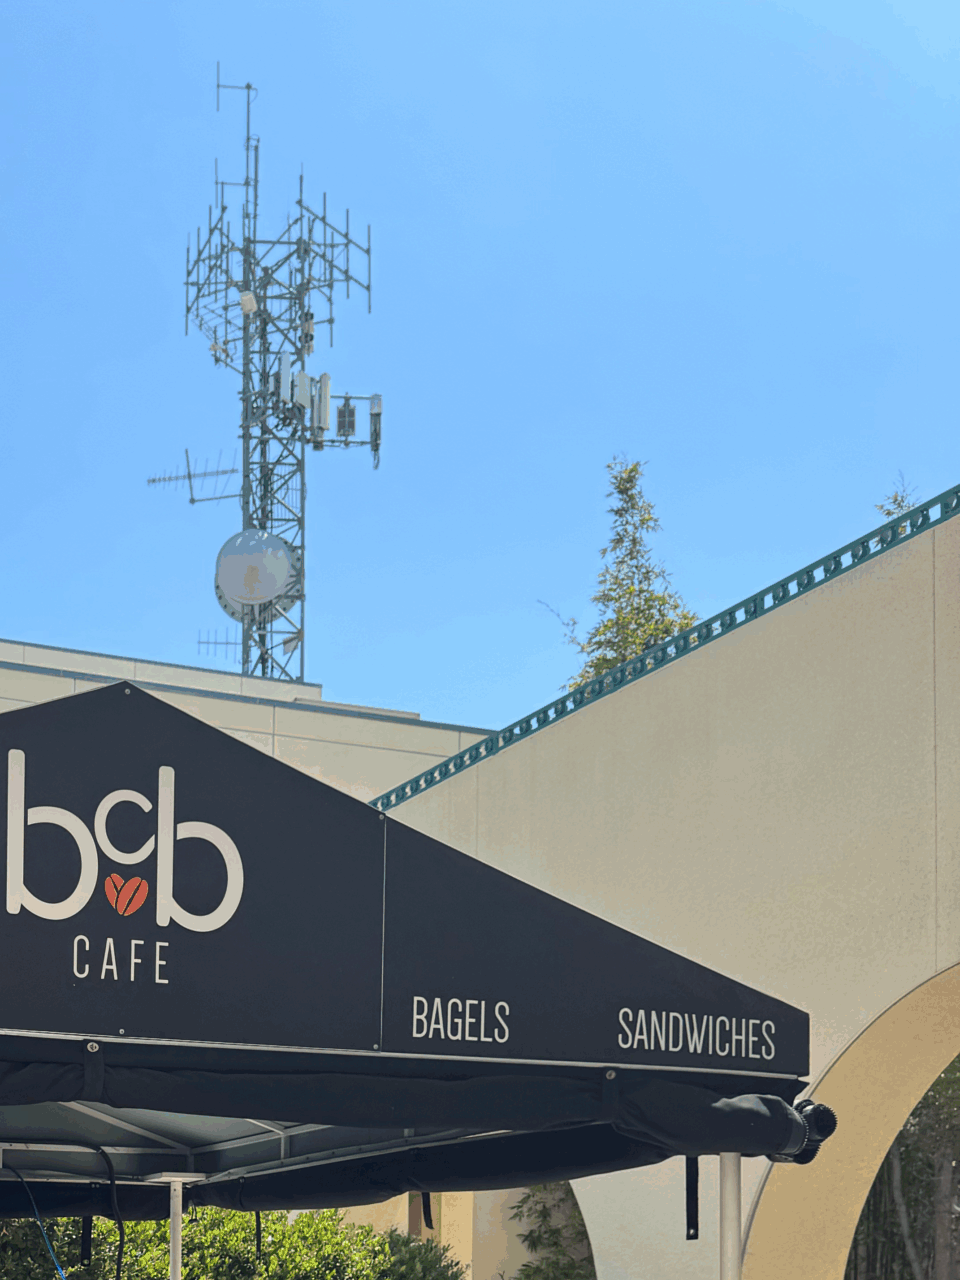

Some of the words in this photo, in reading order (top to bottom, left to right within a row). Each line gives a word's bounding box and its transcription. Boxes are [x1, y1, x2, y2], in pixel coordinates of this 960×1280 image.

[6, 749, 244, 932] bcb
[73, 934, 169, 984] CAFE
[412, 996, 510, 1043] BAGELS
[618, 1007, 776, 1060] SANDWICHES
